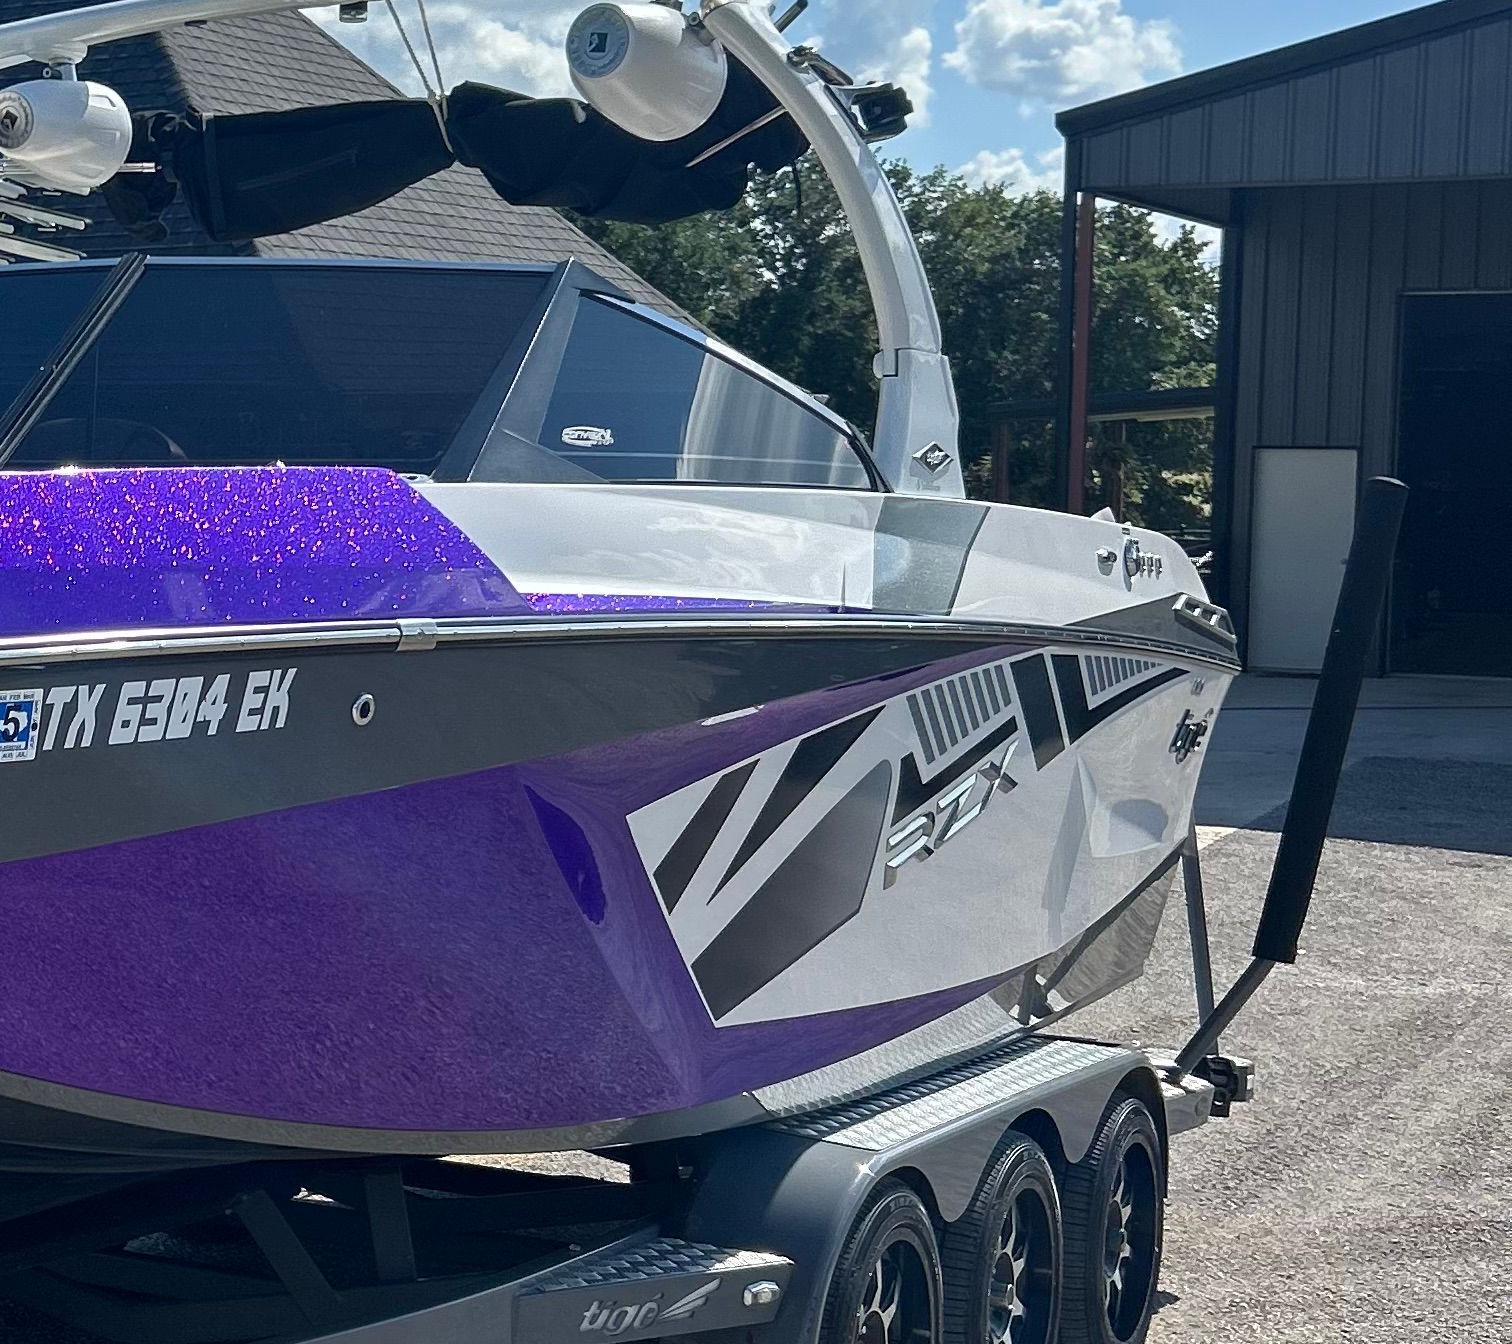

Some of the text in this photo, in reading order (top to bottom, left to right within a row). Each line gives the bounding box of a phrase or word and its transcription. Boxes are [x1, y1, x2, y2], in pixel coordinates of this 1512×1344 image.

[2, 703, 23, 742] 5
[42, 683, 107, 751] TX
[108, 673, 231, 745] 6304
[235, 667, 297, 733] EK
[883, 738, 1020, 891] RZX
[580, 1291, 664, 1336] tigé
